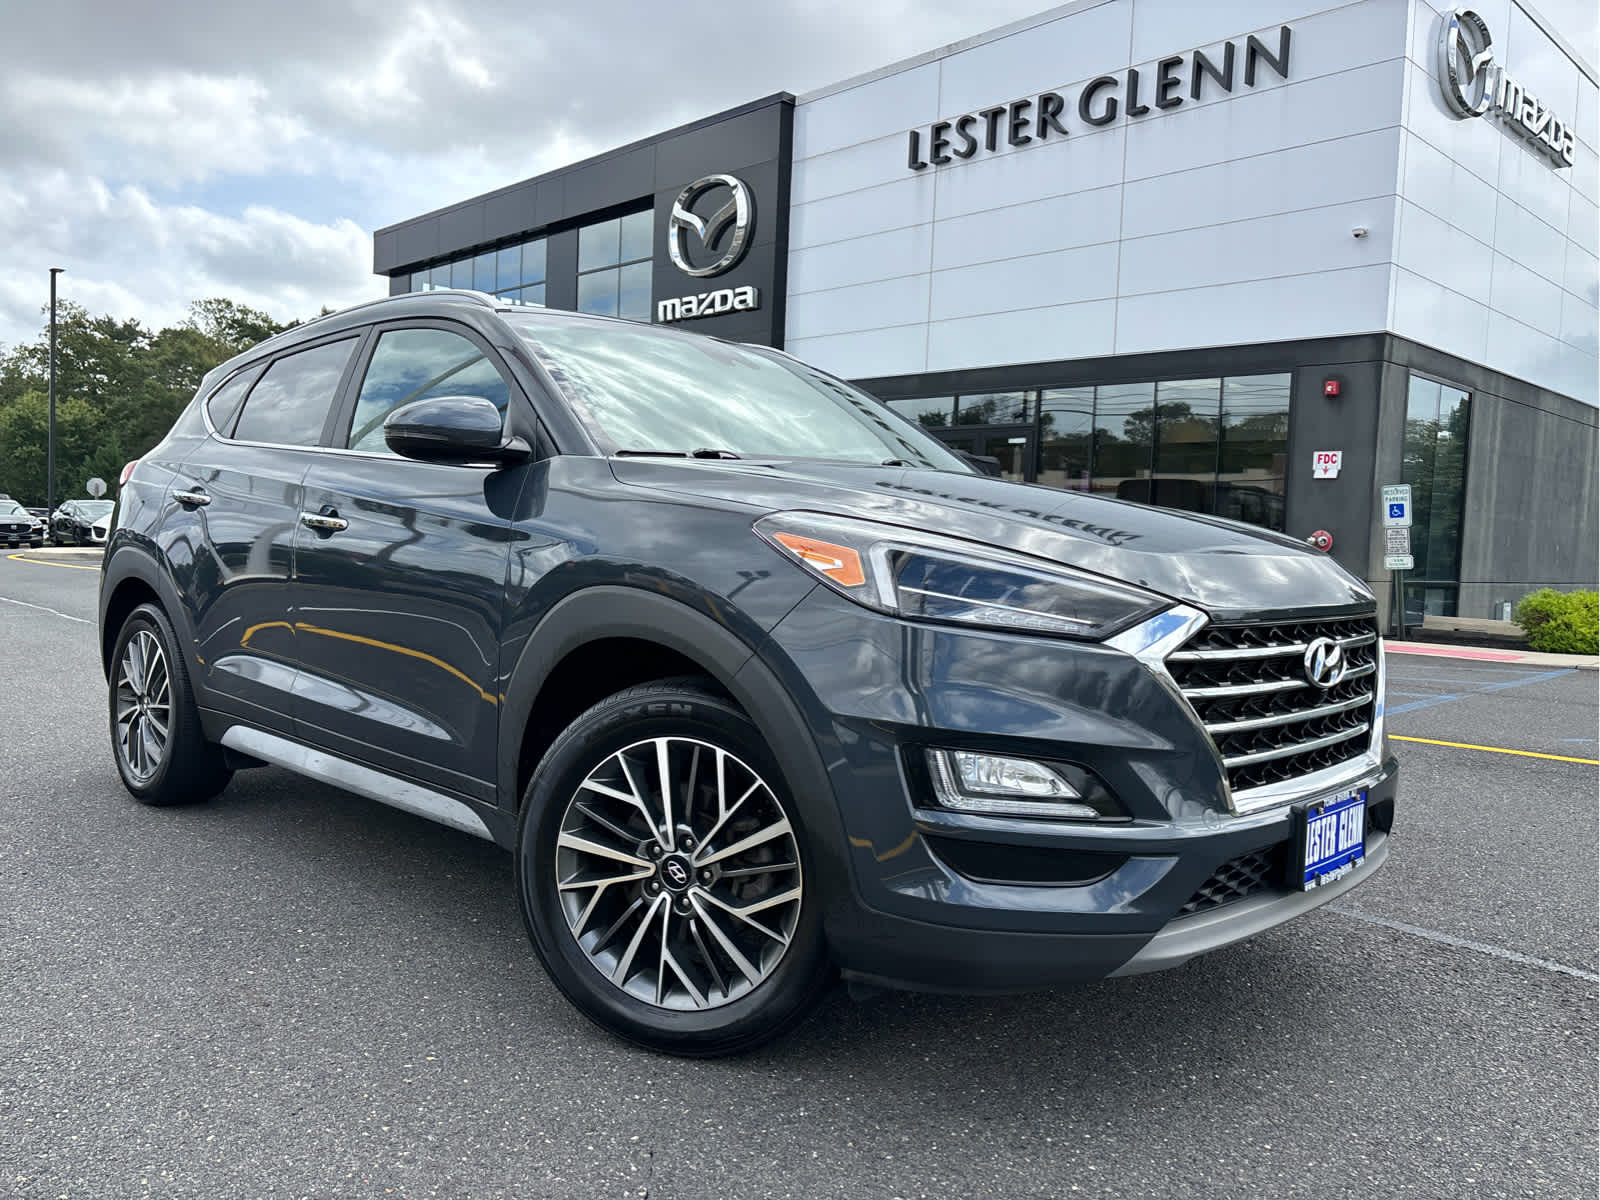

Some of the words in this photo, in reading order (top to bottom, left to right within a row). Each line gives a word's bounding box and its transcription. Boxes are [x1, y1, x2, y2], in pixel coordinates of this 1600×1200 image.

[908, 92, 1069, 171] LESTER
[1078, 25, 1292, 127] GLENN
[658, 286, 757, 322] mazda
[1317, 453, 1338, 465] FDC
[1305, 814, 1337, 867] LESTER
[1338, 804, 1365, 852] GLENN
